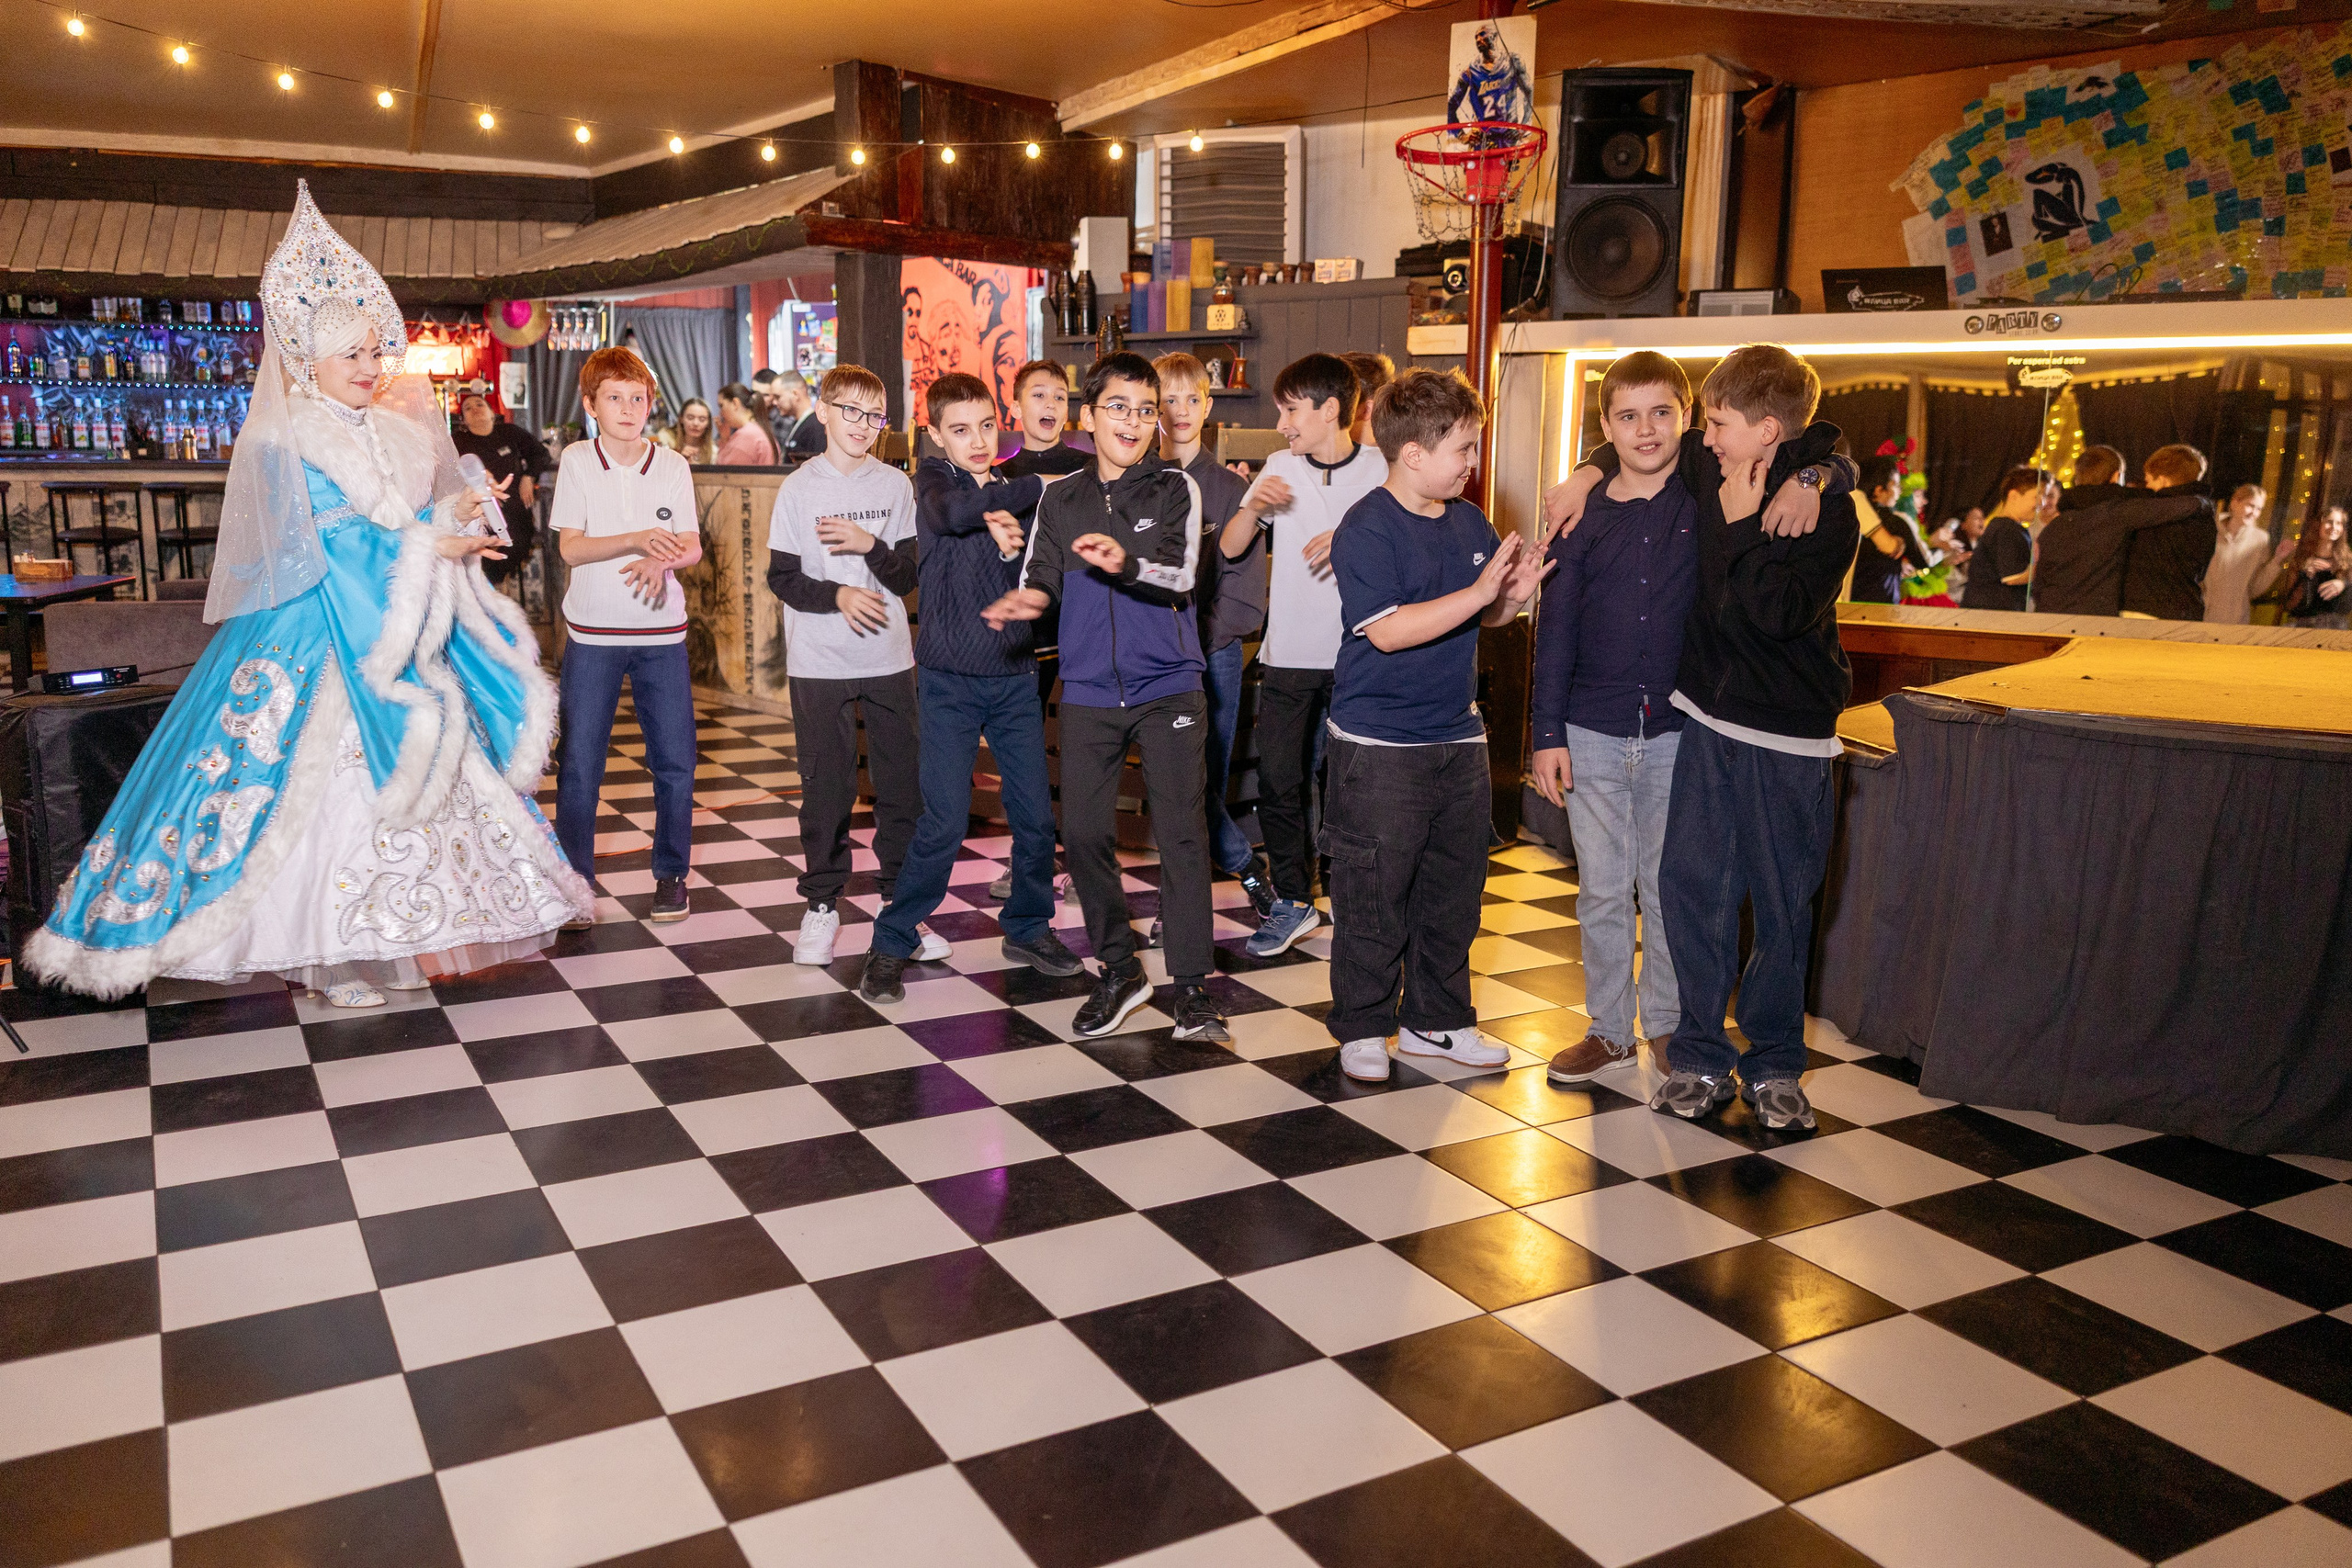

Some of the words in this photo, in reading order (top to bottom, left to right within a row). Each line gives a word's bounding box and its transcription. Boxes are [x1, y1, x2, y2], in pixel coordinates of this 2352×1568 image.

[1482, 94, 1507, 118] 24
[1986, 311, 2039, 334] PARTY
[2007, 355, 2023, 366] Per
[2023, 356, 2051, 367] aspera
[2052, 355, 2064, 365] ad
[2064, 355, 2086, 365] astra
